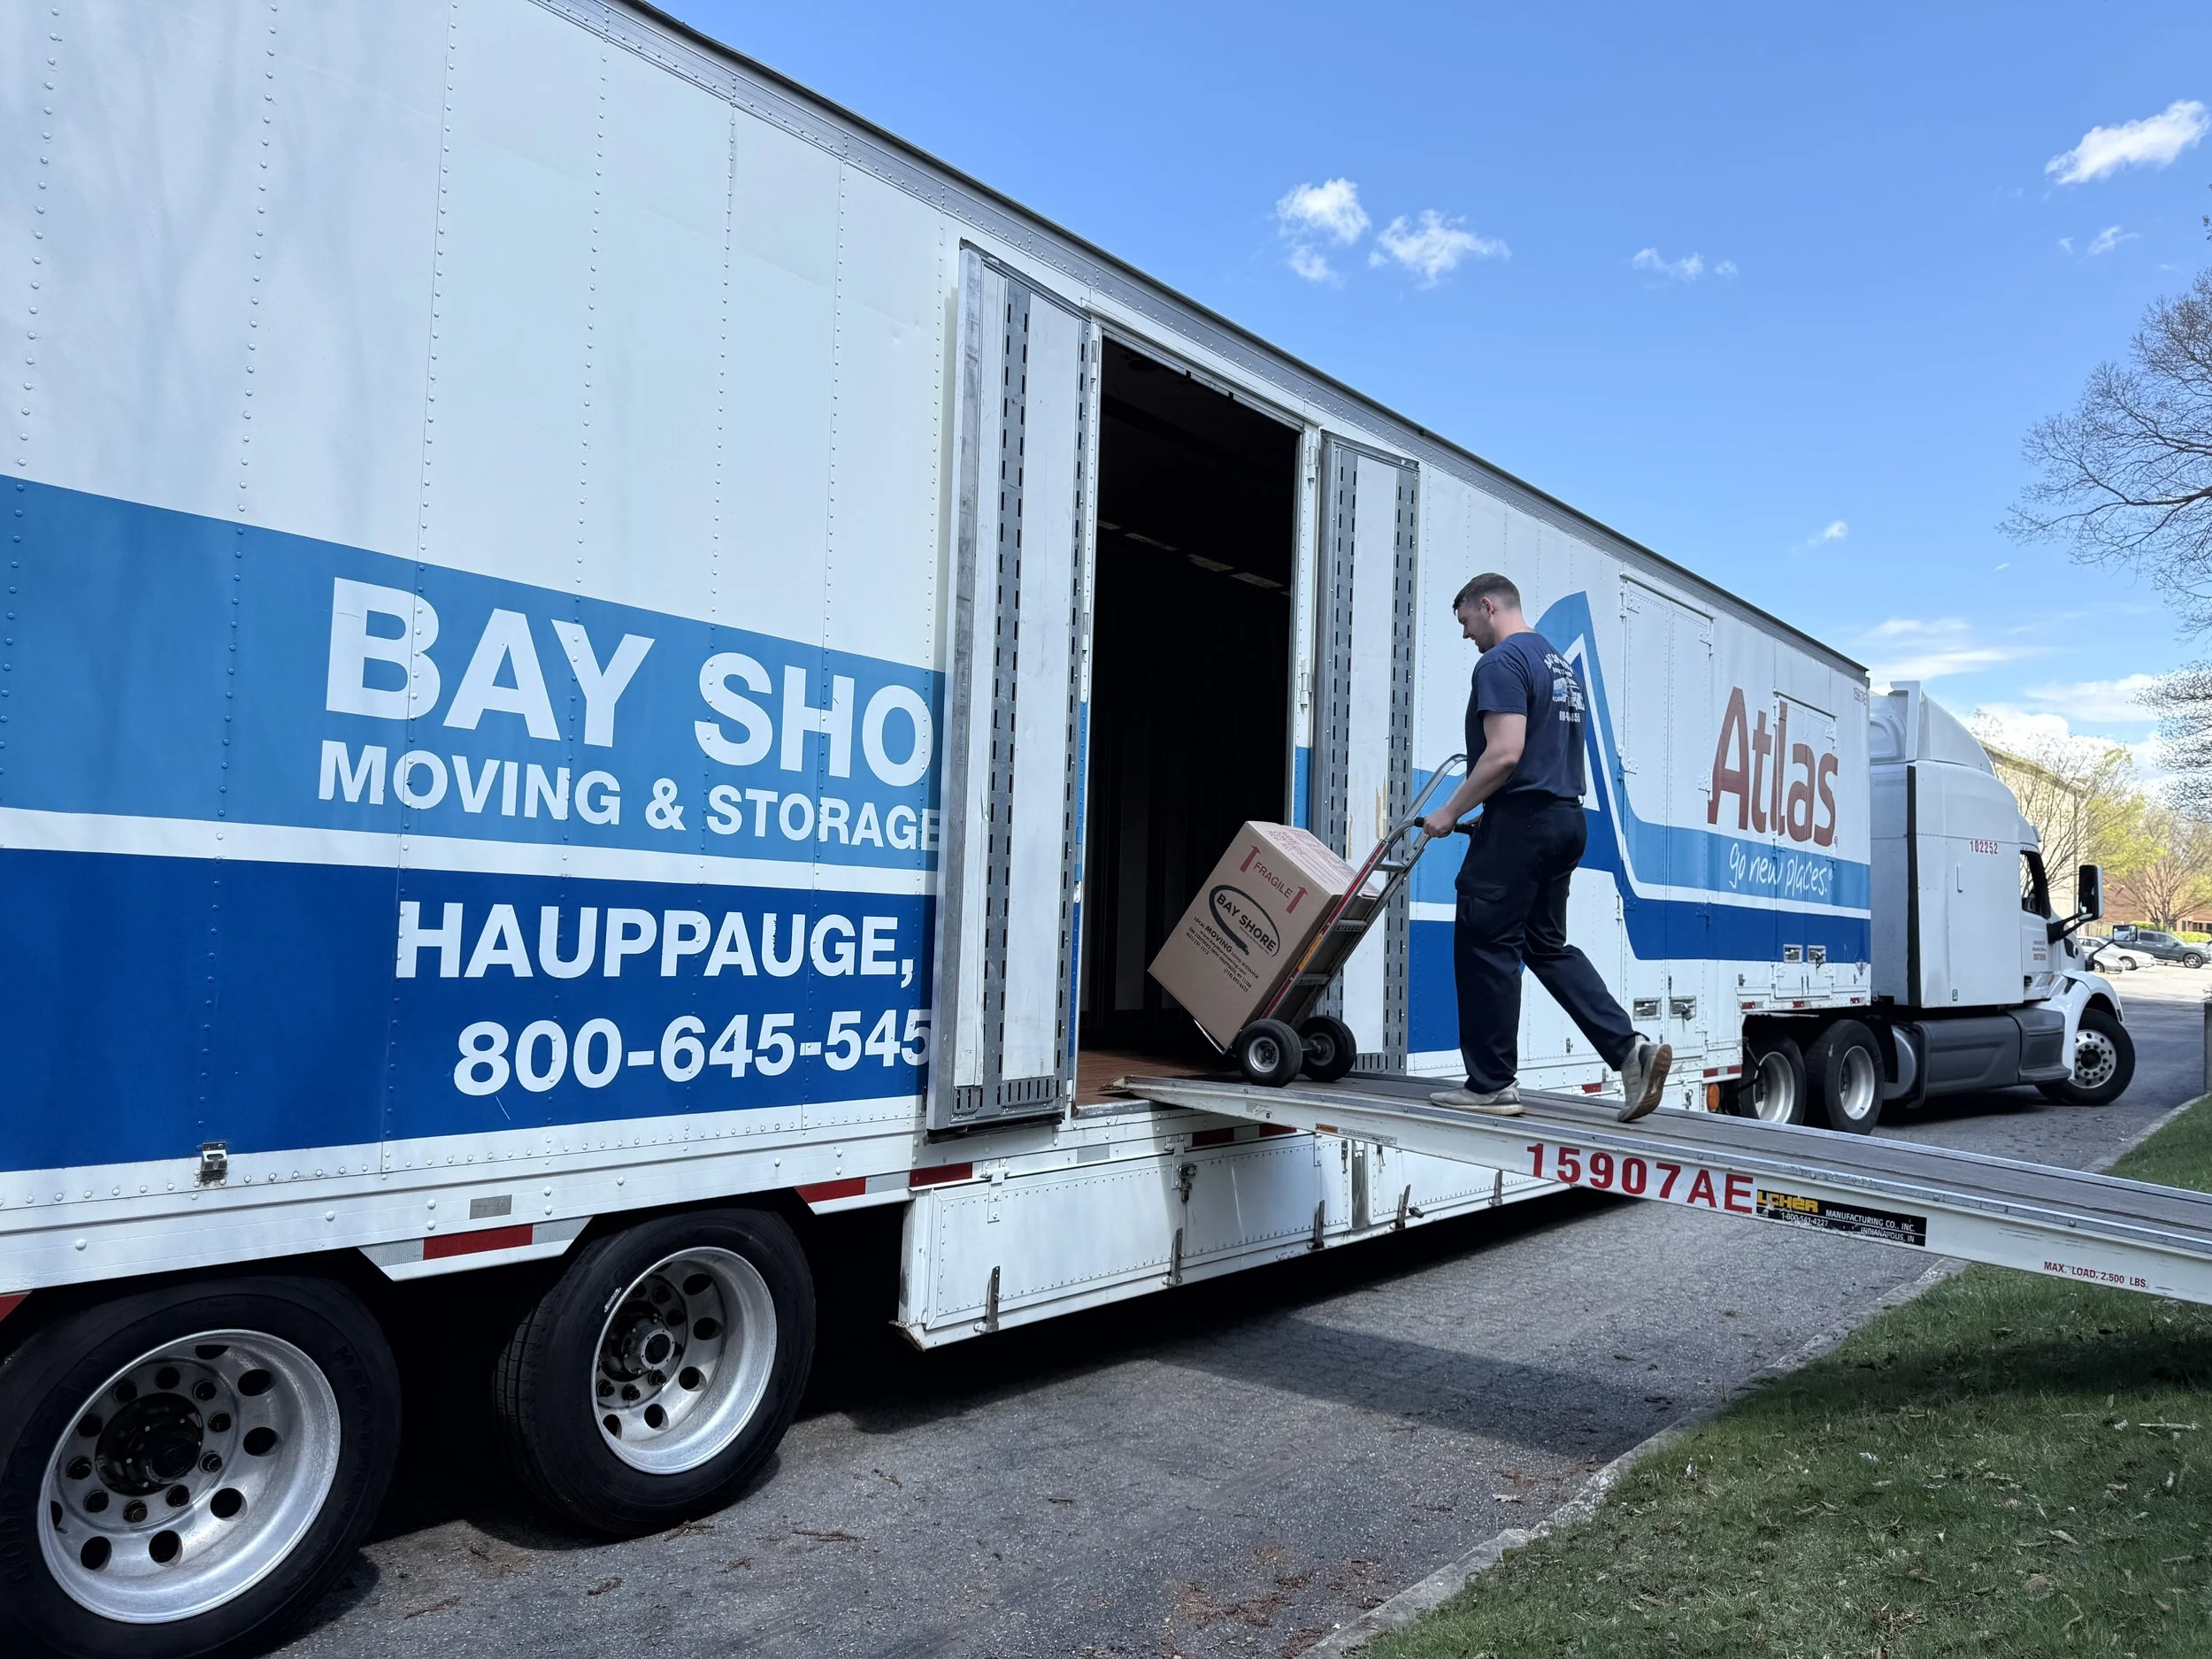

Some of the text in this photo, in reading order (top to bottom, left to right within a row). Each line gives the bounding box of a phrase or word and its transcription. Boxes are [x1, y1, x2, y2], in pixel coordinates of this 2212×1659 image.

[325, 577, 655, 748] BAY
[319, 740, 940, 851] MOVING & STORAGE
[1707, 686, 1839, 847] Atlas
[1729, 842, 1746, 889] go
[1748, 856, 1783, 885] new
[1970, 840, 1998, 855] 102252
[1253, 862, 1293, 898] FRAGILE
[396, 901, 914, 987] HAUPPAUGE,
[1205, 925, 1233, 953] MOVING
[1216, 894, 1240, 917] BAY
[1239, 914, 1277, 952] SHORE
[453, 1009, 931, 1096] 800-645-545
[1526, 1143, 1754, 1214] 15907AE
[1825, 1210, 1884, 1226] MANUFACTURING
[1901, 1223, 1916, 1233] INC.
[2044, 1261, 2067, 1273] MAX.
[2129, 1277, 2148, 1288] LBS.
